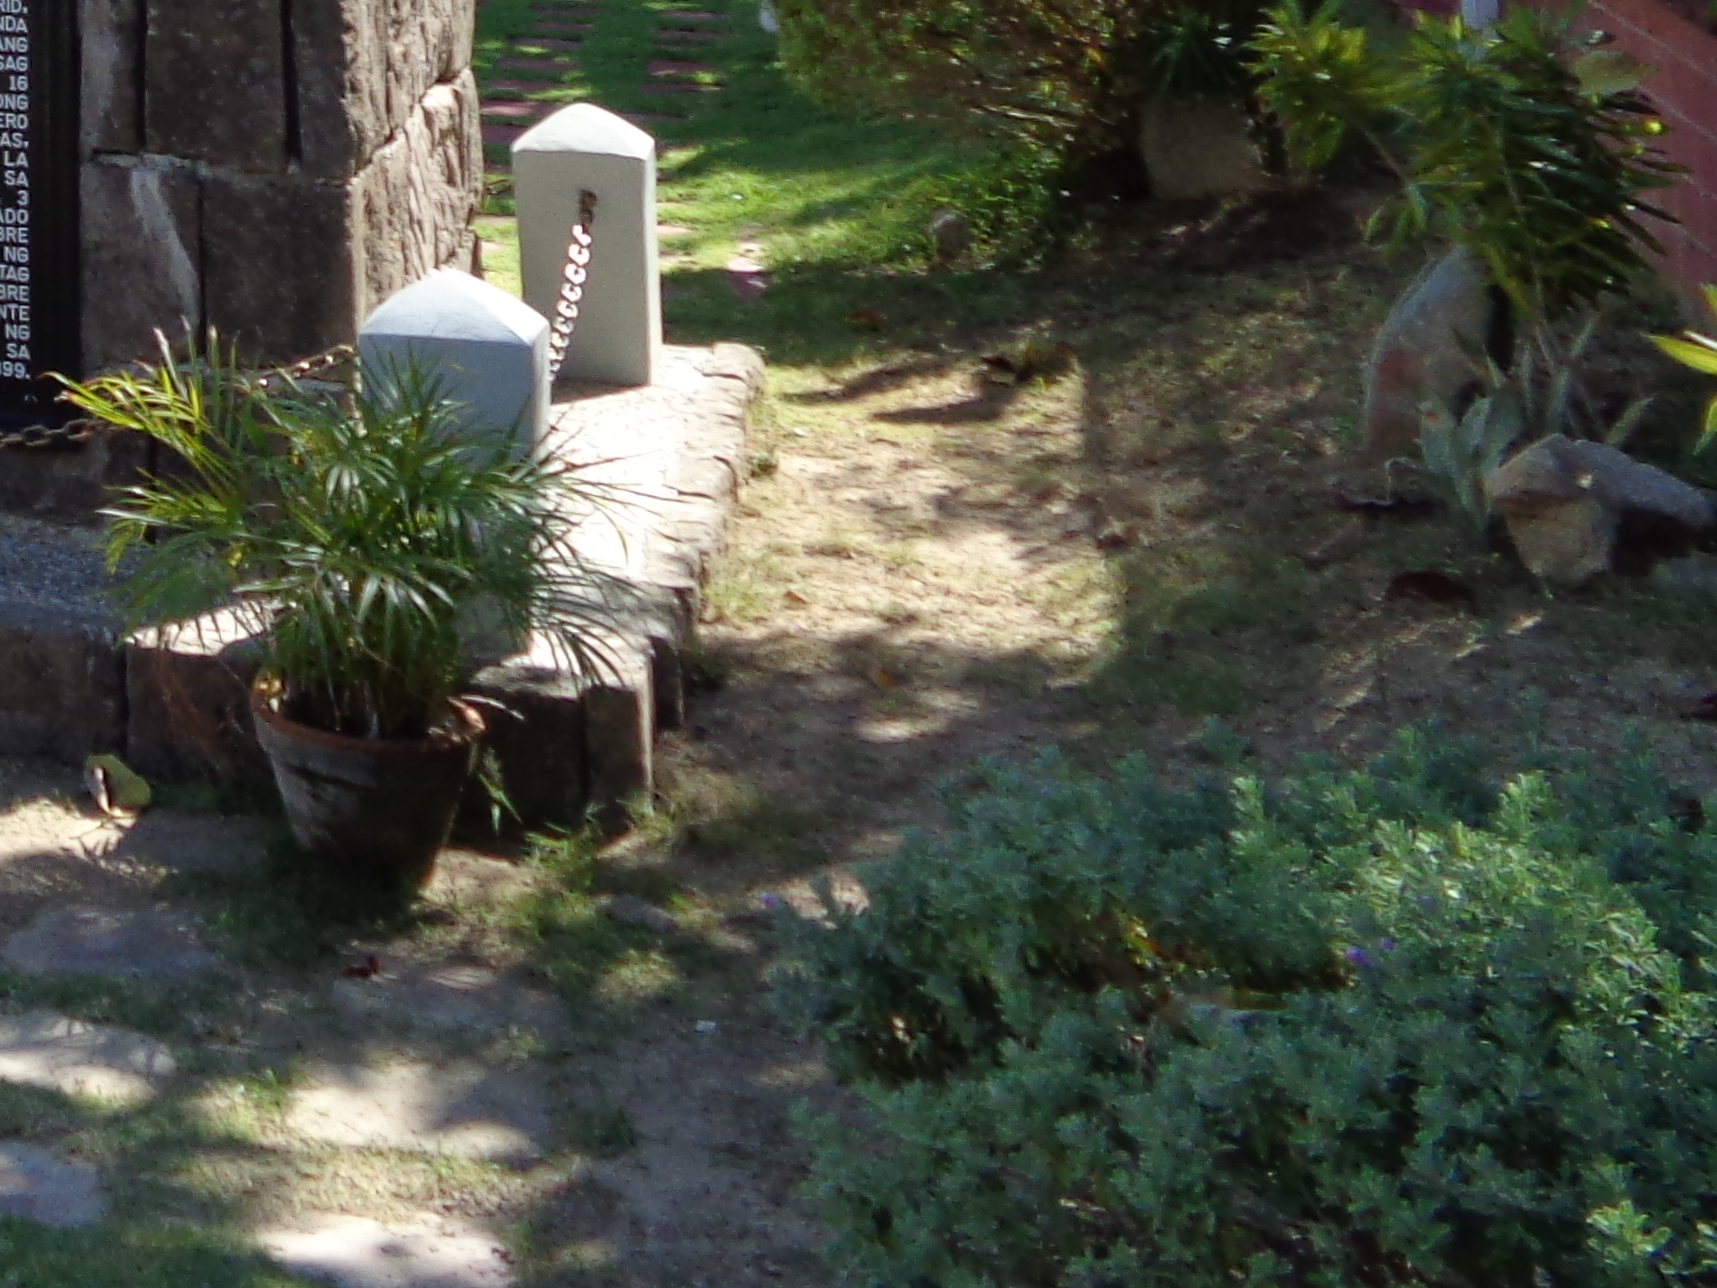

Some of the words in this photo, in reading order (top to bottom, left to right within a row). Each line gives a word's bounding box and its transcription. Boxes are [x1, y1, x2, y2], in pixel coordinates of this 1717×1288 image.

[3, 149, 28, 167] LA
[4, 168, 28, 186] SA
[16, 188, 28, 206] 3
[6, 341, 30, 360] SA
